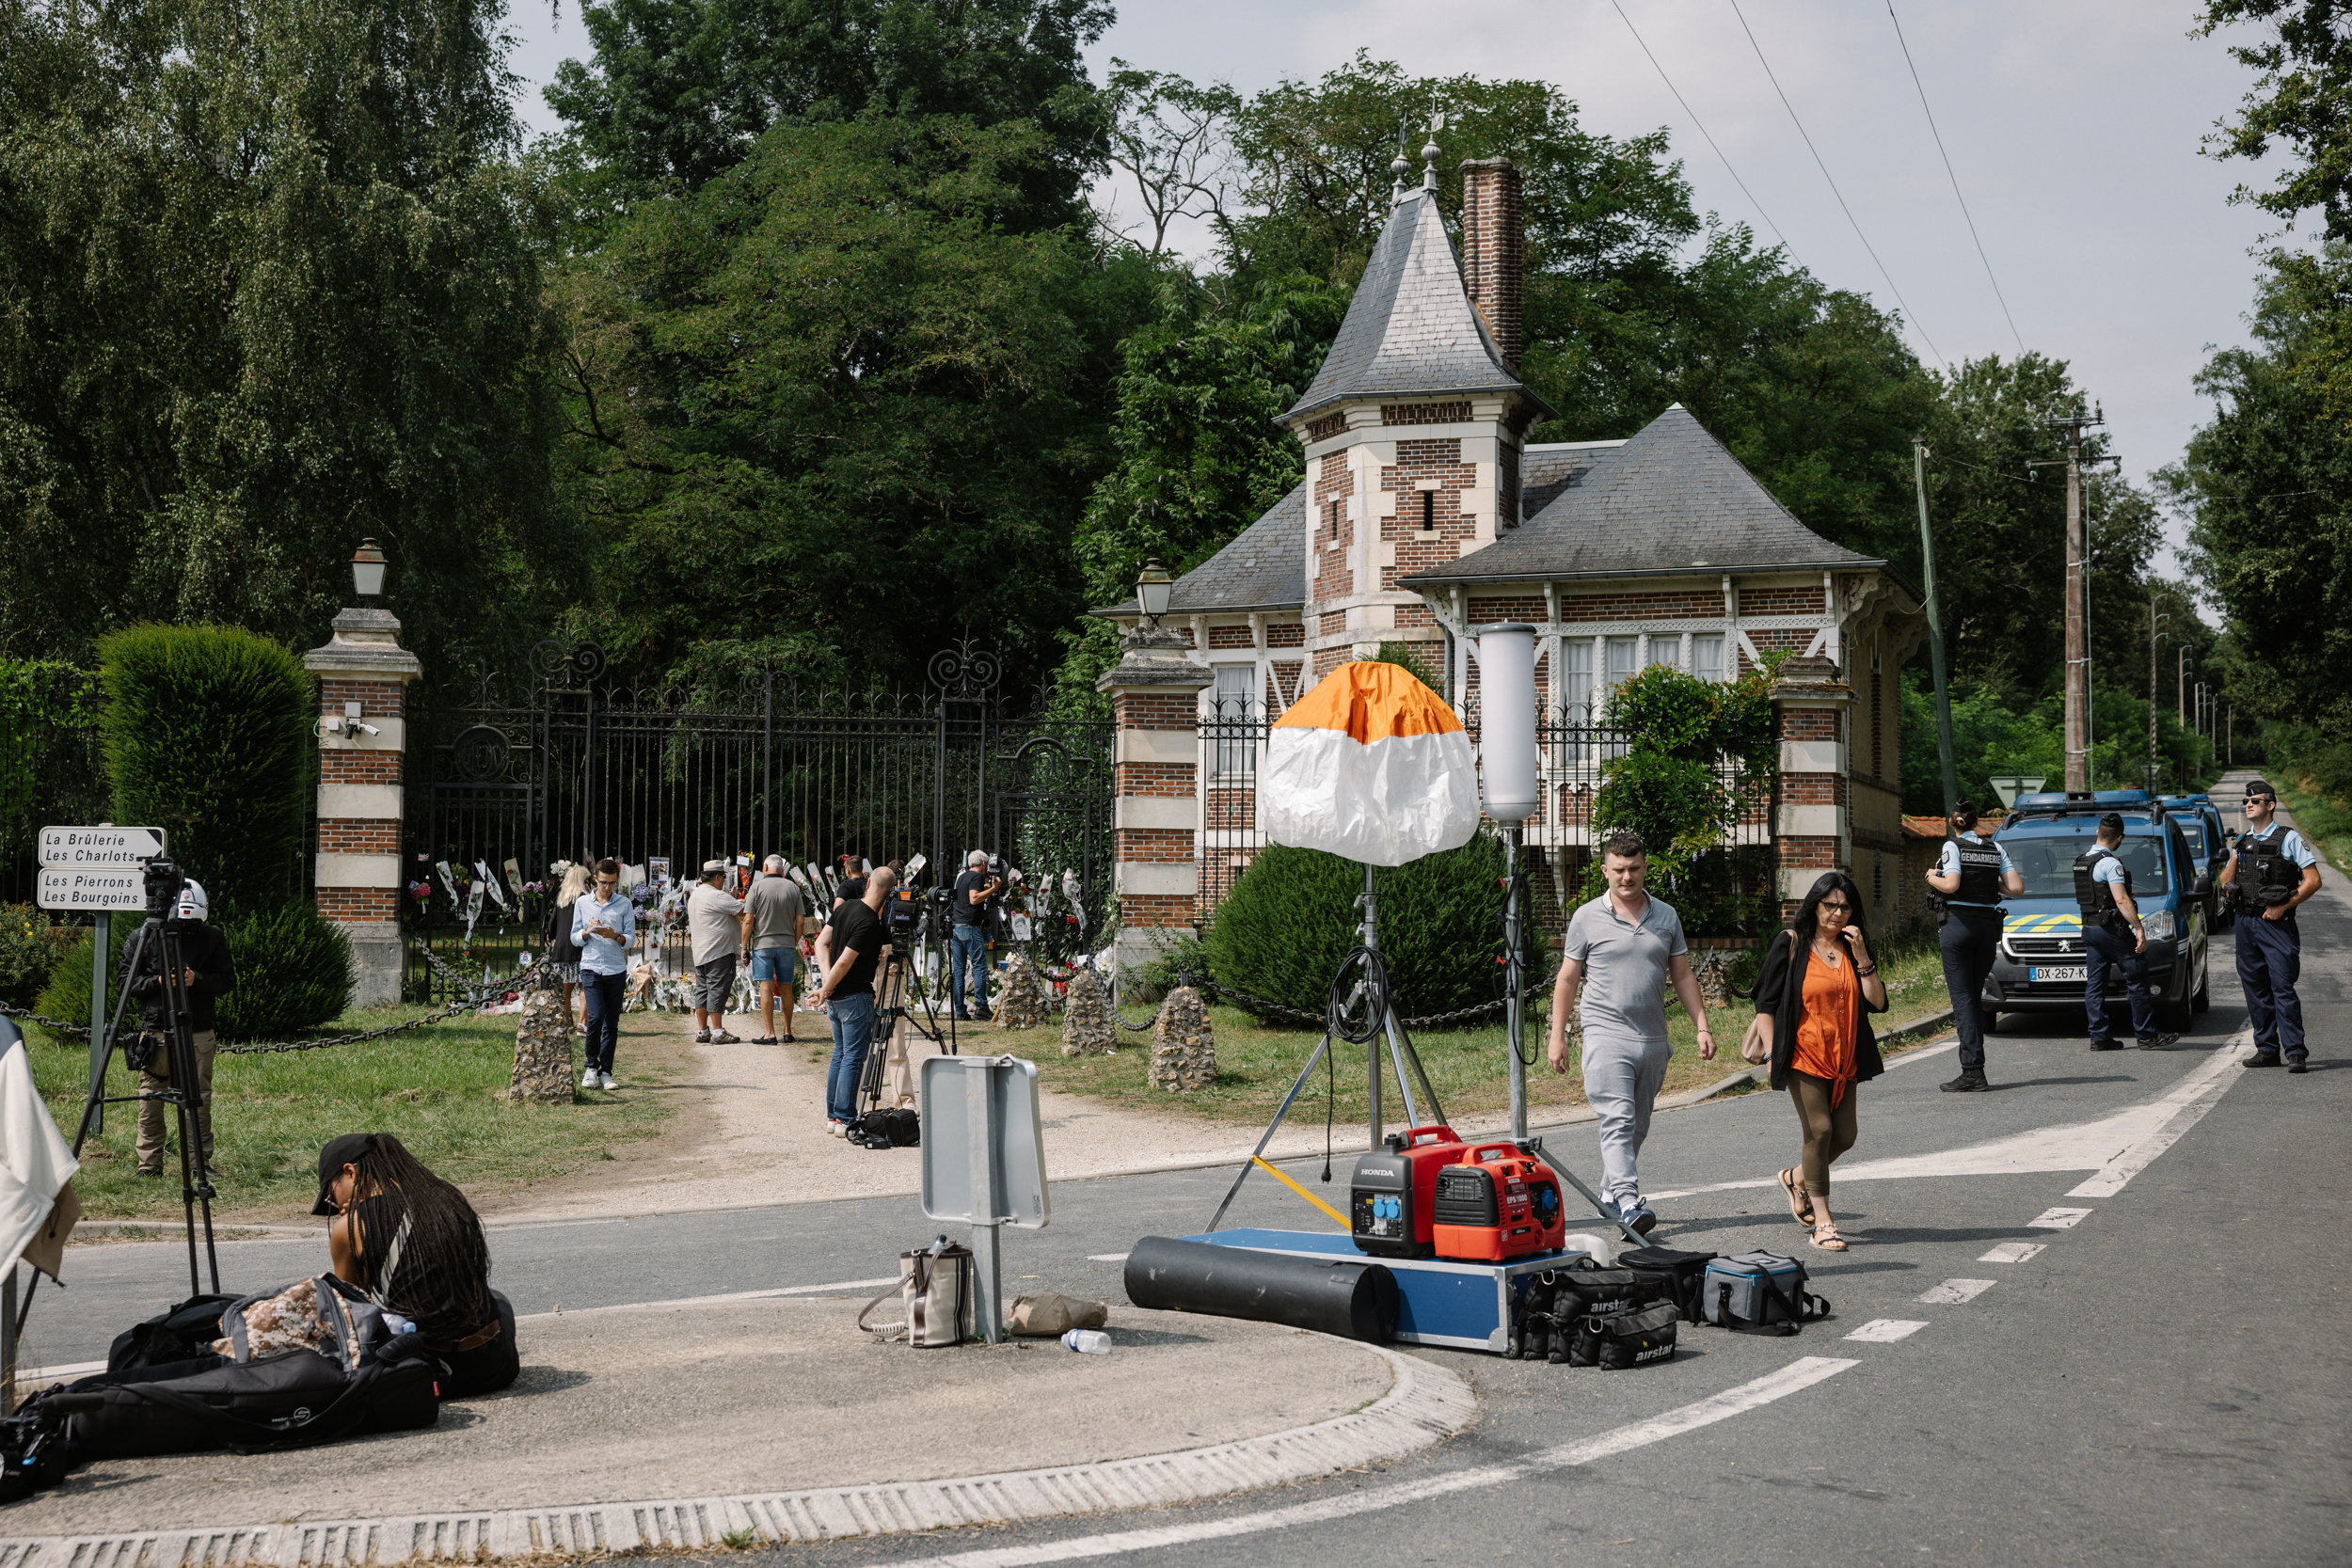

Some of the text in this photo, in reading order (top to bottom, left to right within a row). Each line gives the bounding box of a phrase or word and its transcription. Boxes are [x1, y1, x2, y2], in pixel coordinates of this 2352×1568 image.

[46, 833, 125, 846] La Brûlerie
[46, 849, 135, 862] Les Charlots
[1962, 852, 2001, 863] GENDARMERIE
[45, 875, 133, 888] Les Pierrons
[44, 891, 138, 906] Les Bourgoins
[2037, 968, 2088, 979] DX-267-K
[1636, 1344, 1673, 1361] airstar
